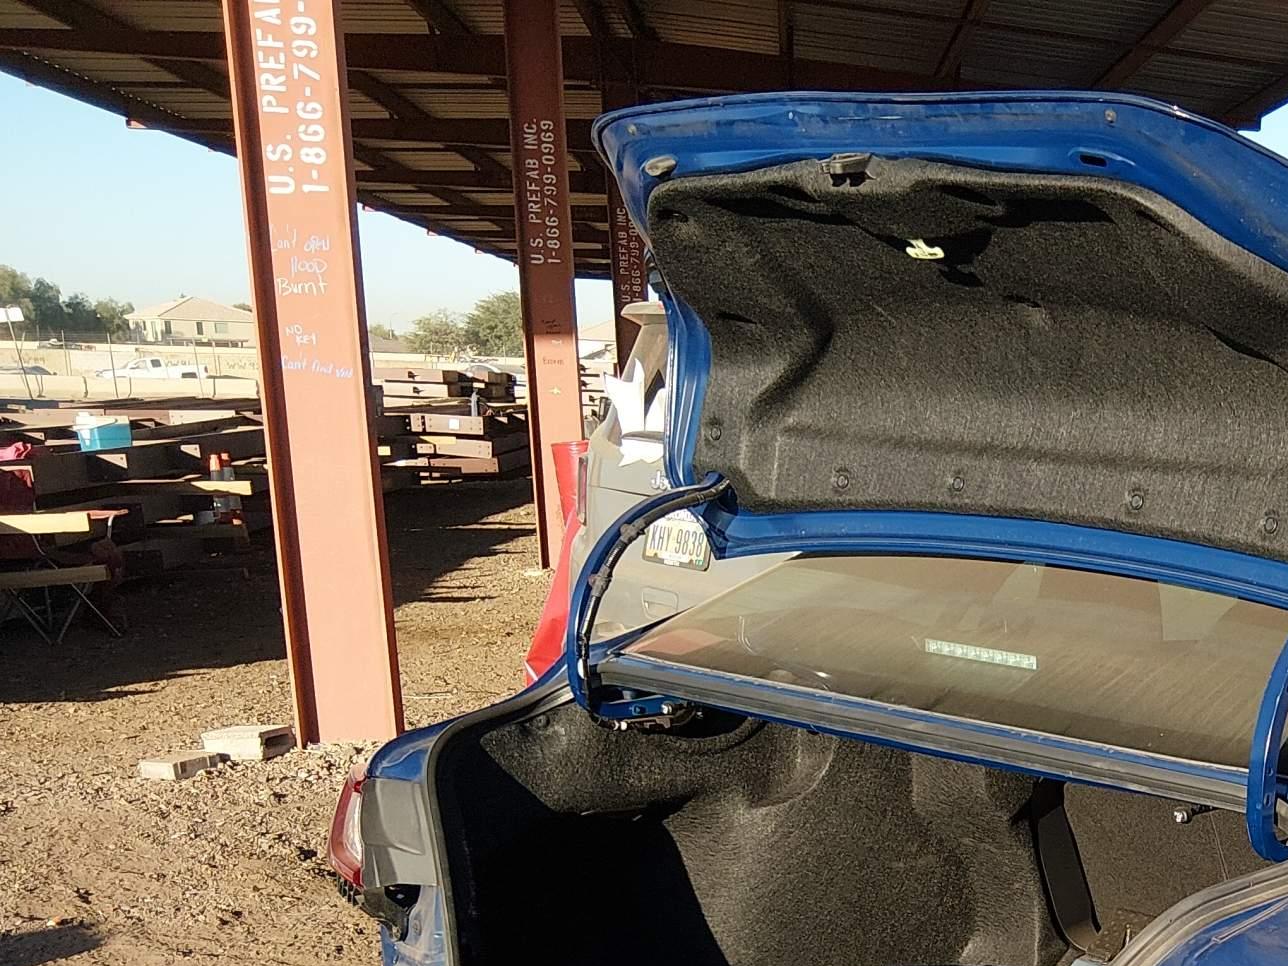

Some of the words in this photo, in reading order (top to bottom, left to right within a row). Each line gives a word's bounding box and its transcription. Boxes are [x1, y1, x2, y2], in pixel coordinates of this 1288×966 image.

[253, 0, 290, 114] PREFA
[289, 0, 330, 193] 1-866-799-
[523, 118, 538, 150] INC.
[265, 133, 296, 195] U.S.
[525, 158, 542, 223] PREFAB
[540, 120, 561, 263] 1-866-799-0969
[530, 233, 544, 264] U.S.
[617, 231, 629, 275] PREFAB
[277, 274, 328, 296] Burnt
[620, 280, 631, 302] U.S.
[285, 324, 303, 337] NO
[649, 523, 673, 552] KHY
[675, 528, 705, 558] 9838
